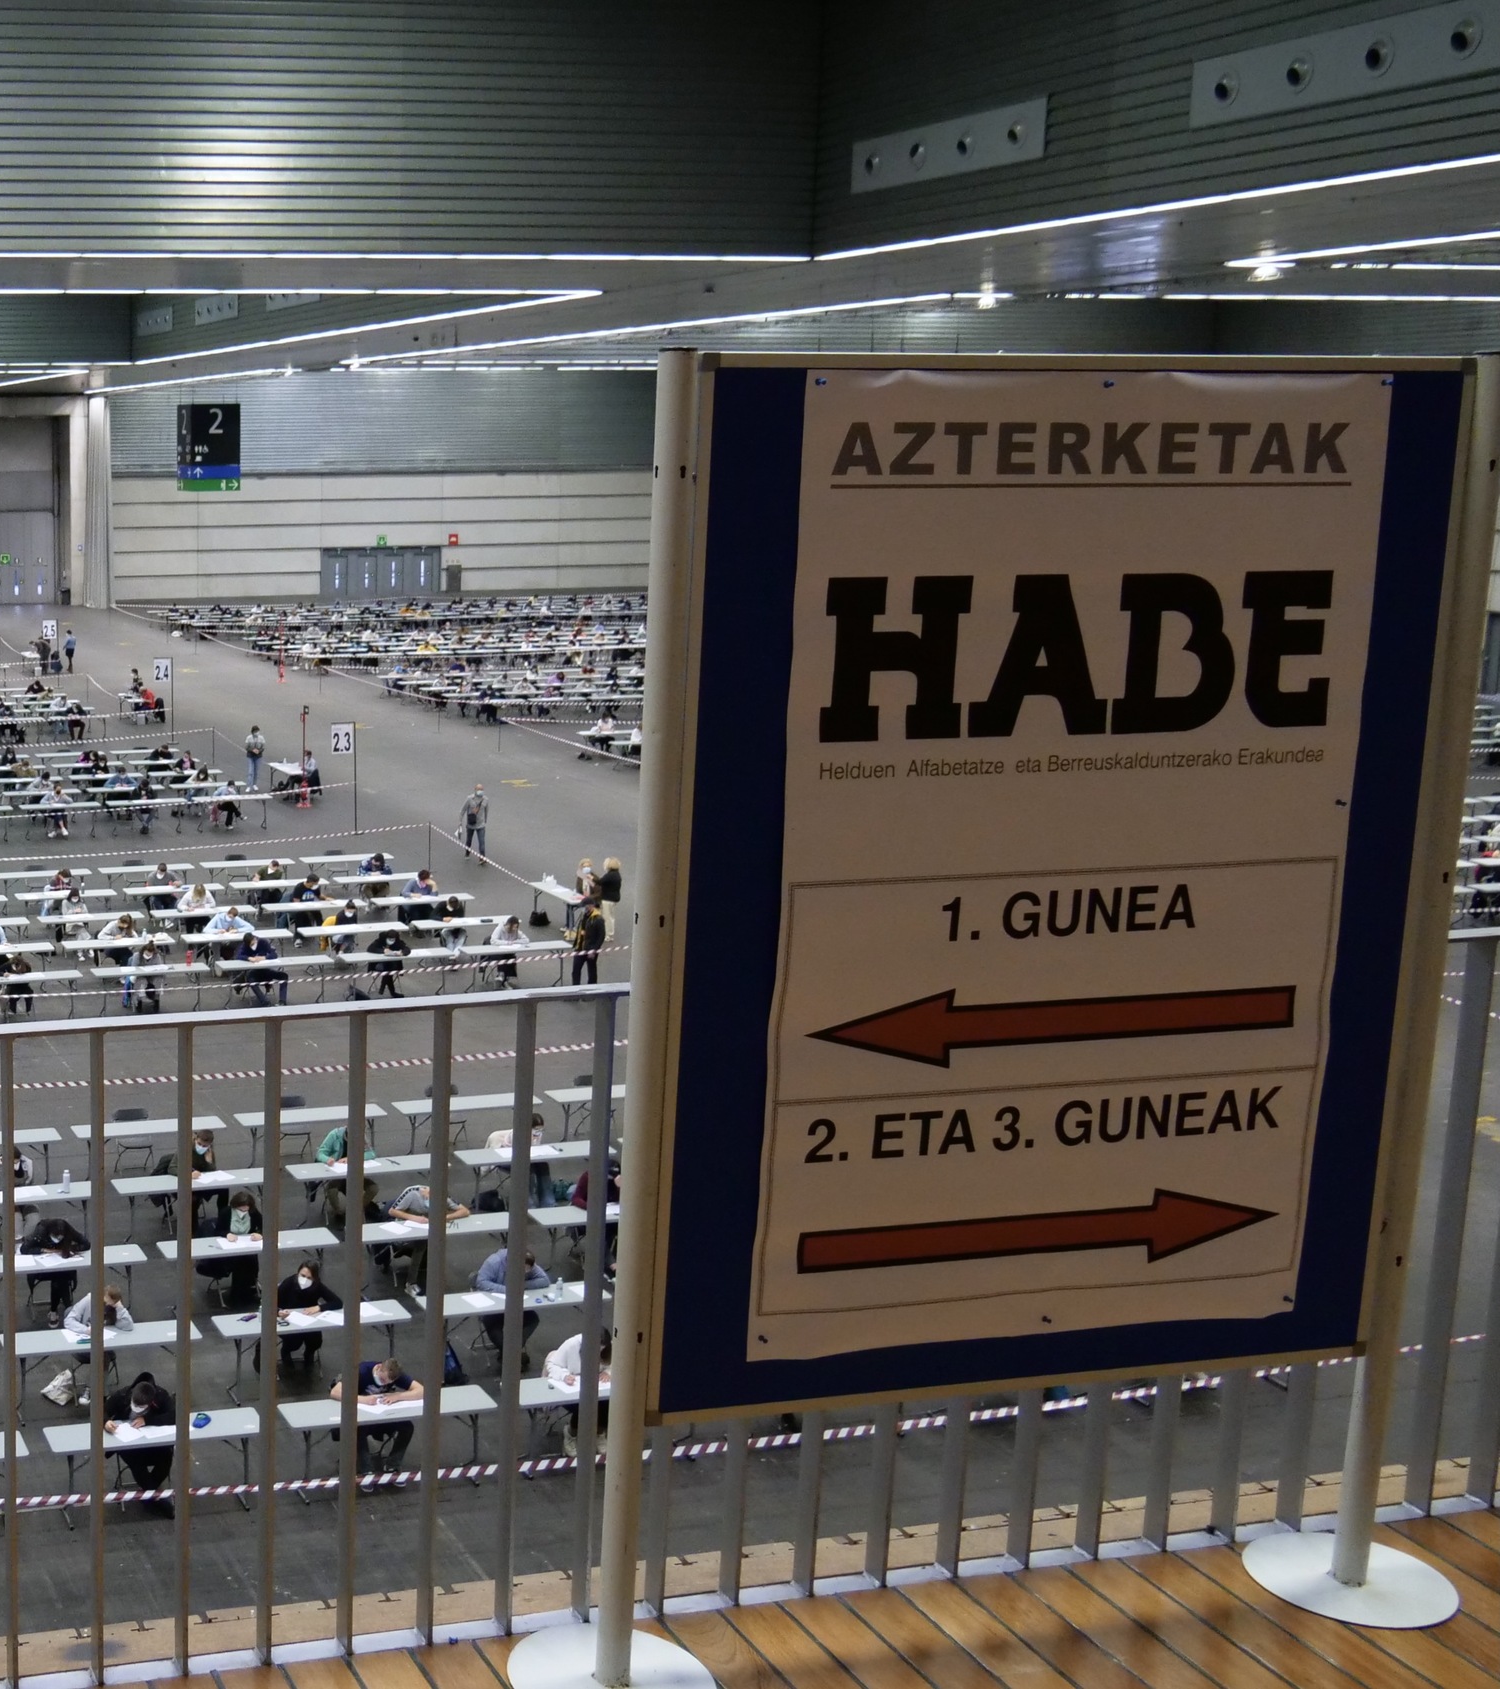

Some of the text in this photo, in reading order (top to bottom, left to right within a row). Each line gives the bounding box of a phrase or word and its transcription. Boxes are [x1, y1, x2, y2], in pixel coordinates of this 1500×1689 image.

[208, 408, 224, 434] 2
[831, 421, 1351, 476] AZTERKETAK
[155, 665, 169, 680] 2.4
[818, 569, 1335, 744] HABE
[333, 732, 351, 752] 2.3
[819, 745, 1325, 780] Helduen Alfabetatze eta Berreuskalduntzerako Erakundea
[942, 883, 1197, 942] 1. GUNEA
[804, 1085, 1283, 1164] 2. ETA 3. GUNEAK
